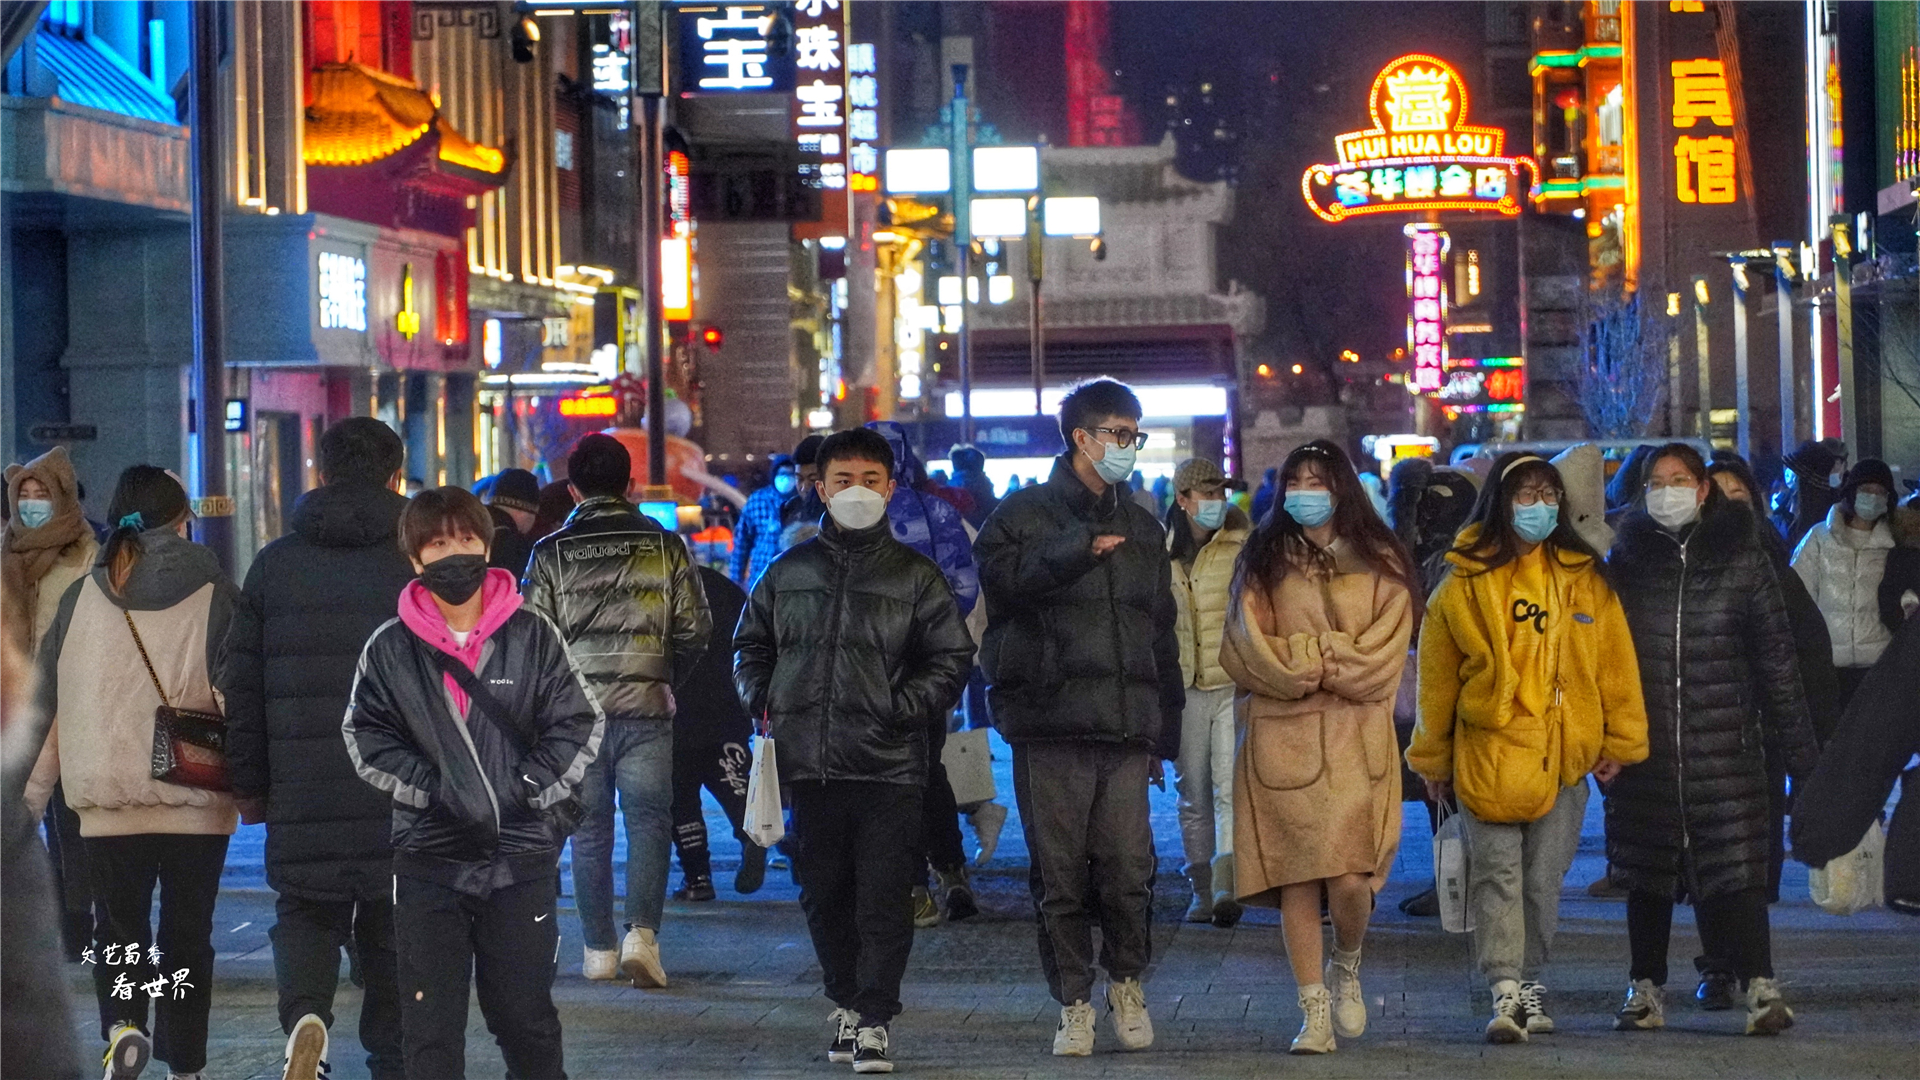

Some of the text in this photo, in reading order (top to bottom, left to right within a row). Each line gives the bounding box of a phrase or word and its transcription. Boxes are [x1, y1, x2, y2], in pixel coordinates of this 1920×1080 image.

[1669, 0, 1736, 204] 宾馆
[1346, 133, 1492, 161] HUI HUA LOU
[563, 541, 630, 561] valued
